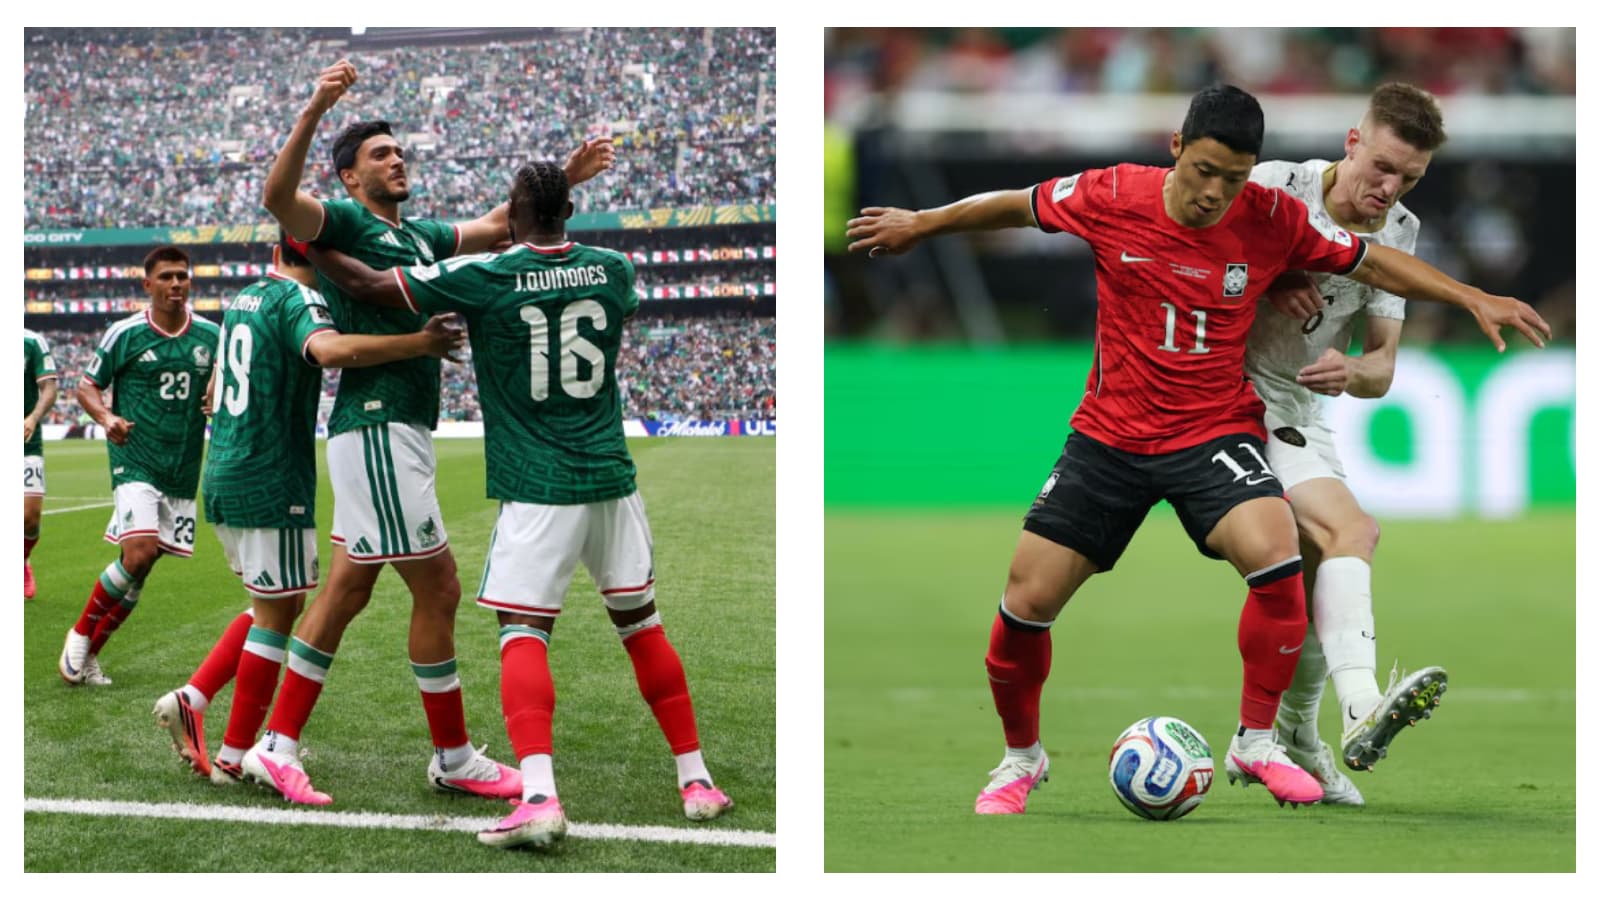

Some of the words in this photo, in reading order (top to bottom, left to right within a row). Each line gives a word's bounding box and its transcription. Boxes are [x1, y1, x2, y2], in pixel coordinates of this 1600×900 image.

[48, 232, 83, 243] CITY
[1157, 302, 1211, 354] 11
[213, 321, 253, 417] 19
[519, 299, 607, 401] 16
[159, 372, 190, 400] 23
[1326, 346, 1576, 518] ar
[24, 467, 43, 487] 24
[1211, 442, 1276, 483] 11
[174, 516, 195, 544] 23
